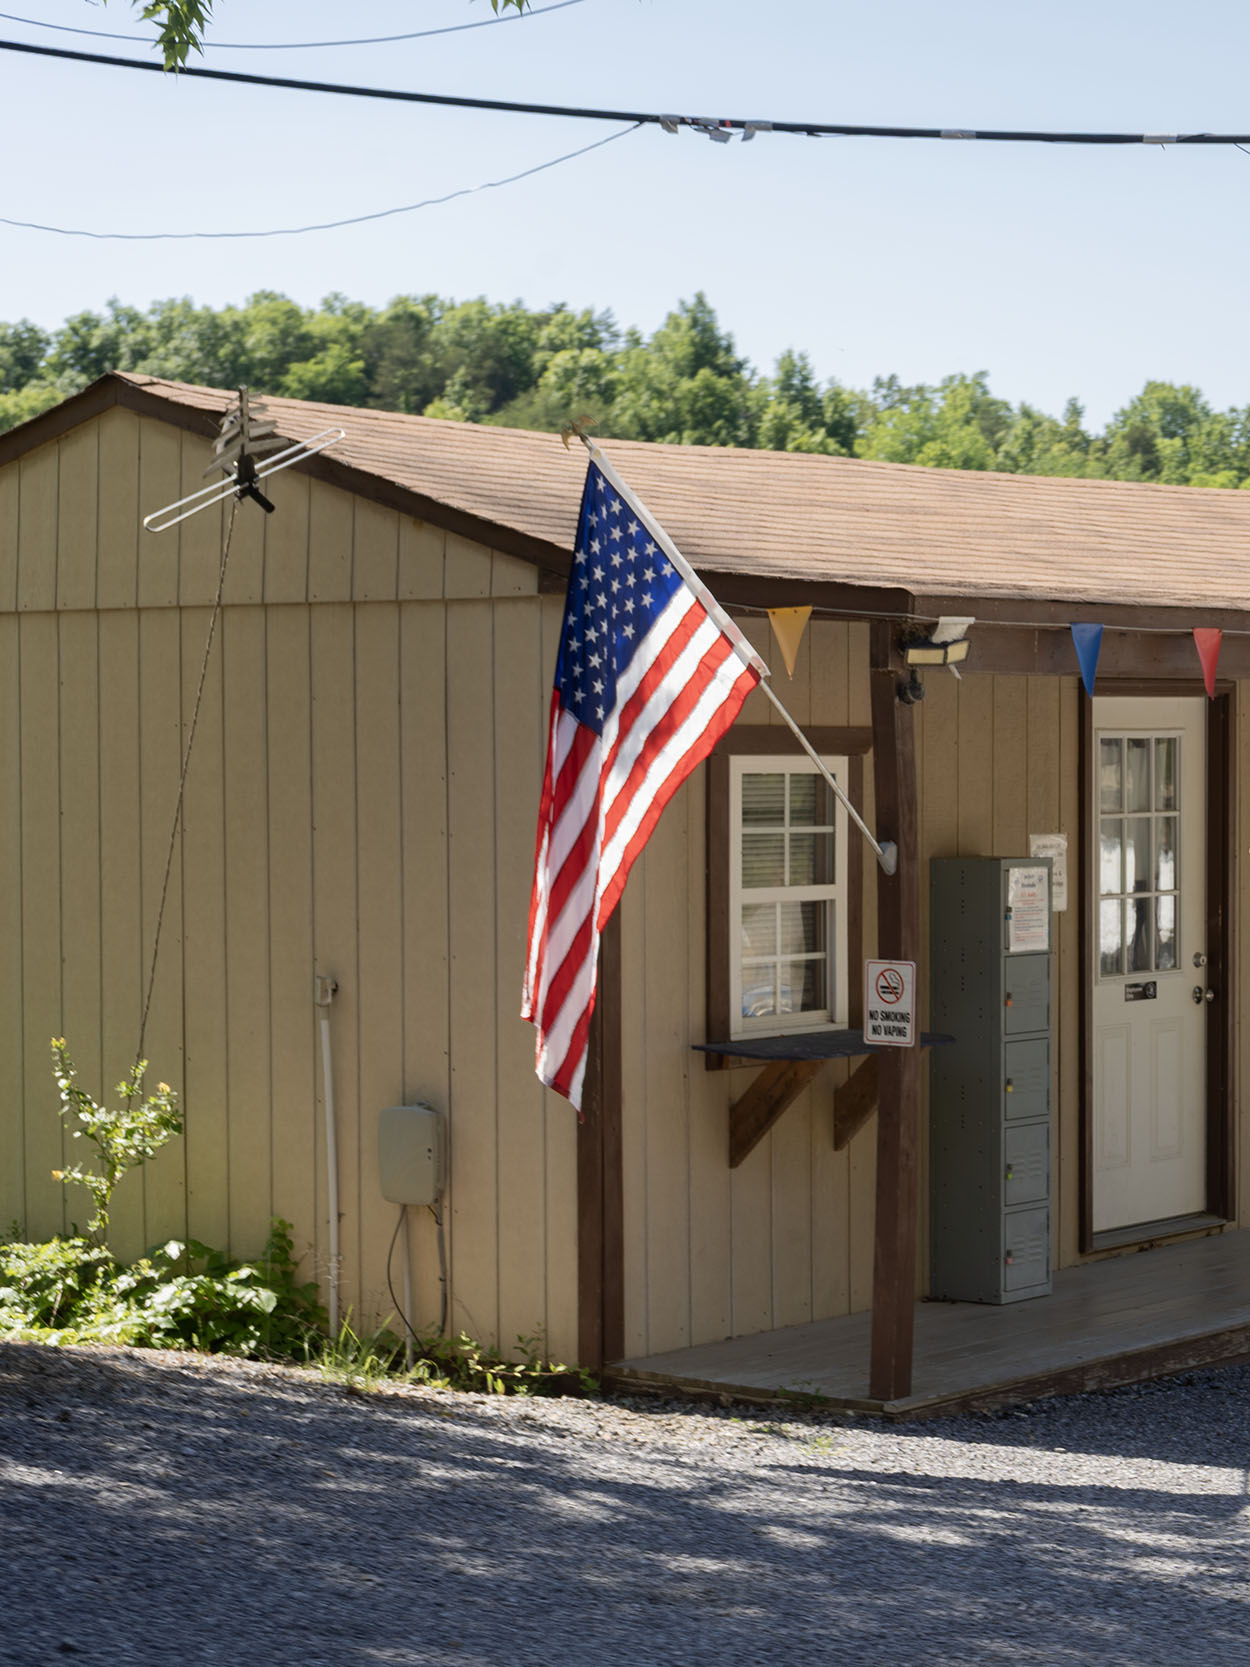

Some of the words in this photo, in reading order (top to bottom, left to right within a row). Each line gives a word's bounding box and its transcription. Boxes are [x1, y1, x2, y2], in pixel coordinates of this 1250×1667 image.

[869, 1009, 879, 1021] NO
[880, 1010, 911, 1024] SMOKING
[871, 1024, 882, 1036] NO
[883, 1025, 907, 1038] VAPING
